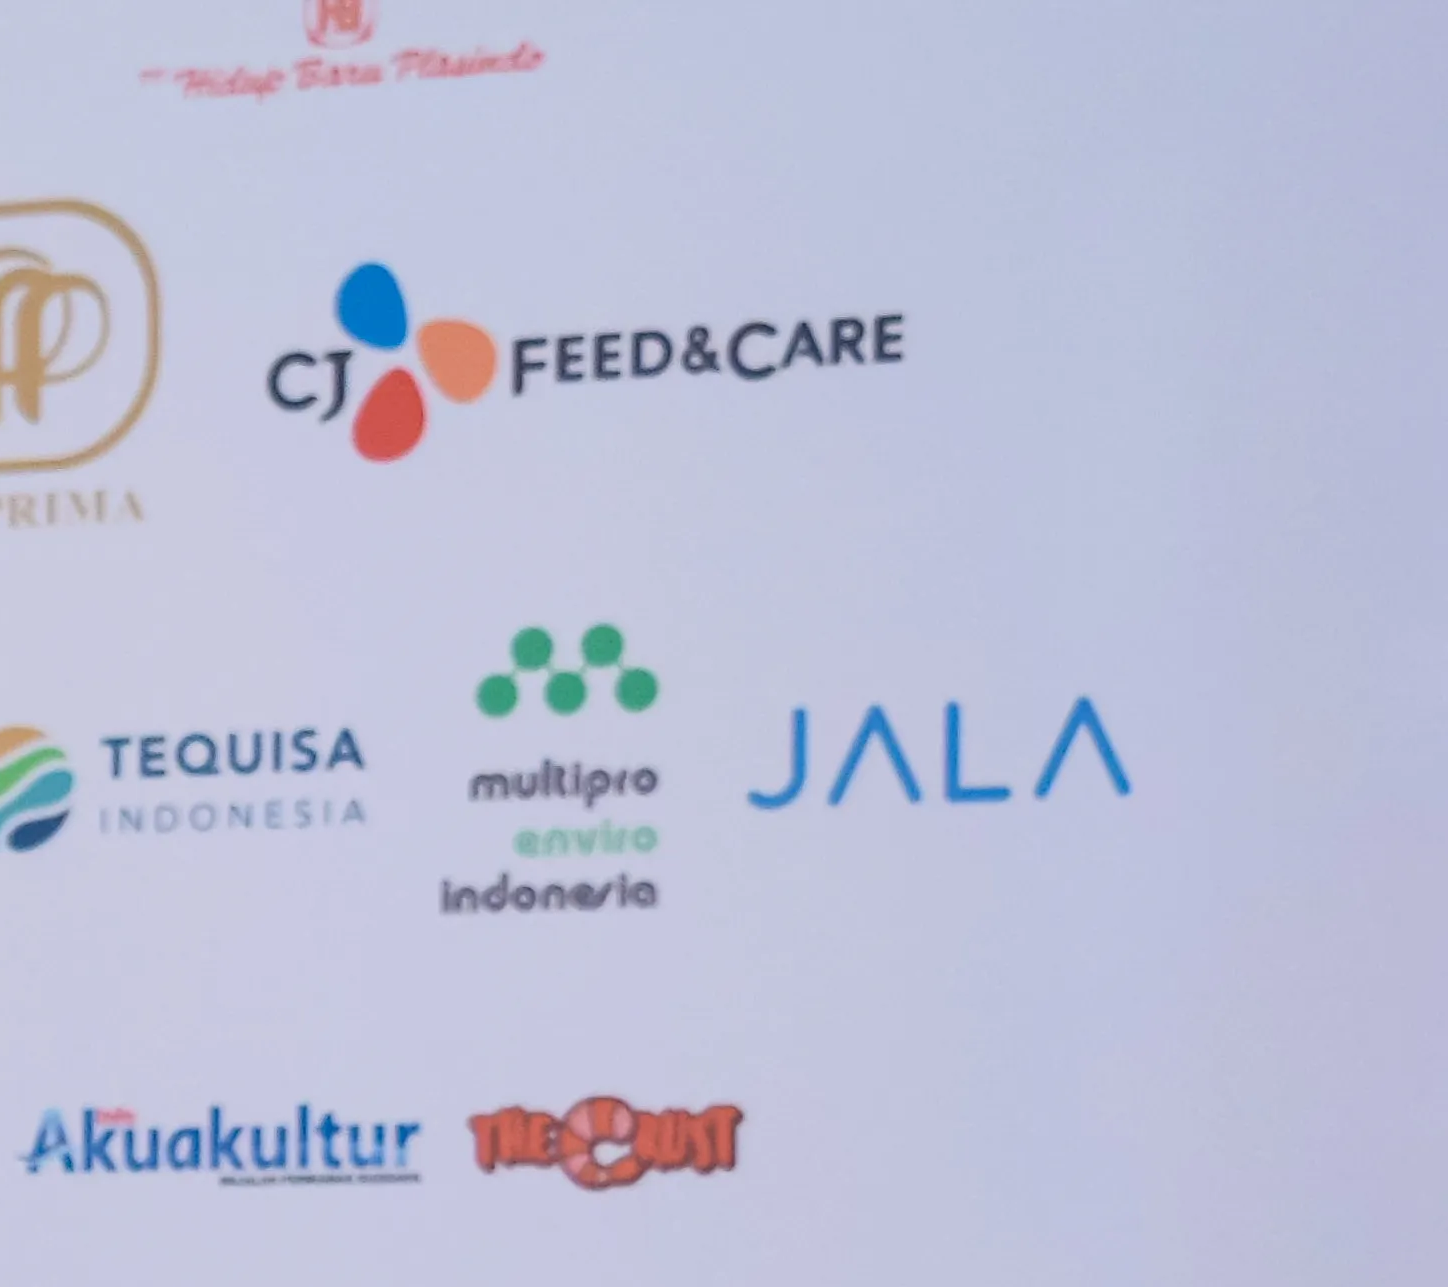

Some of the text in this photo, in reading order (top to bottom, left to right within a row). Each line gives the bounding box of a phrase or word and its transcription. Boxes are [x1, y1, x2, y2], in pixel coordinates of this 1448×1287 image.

[267, 314, 905, 424] CJ FEED&CARE
[100, 727, 366, 779] TEQUISA
[748, 697, 1132, 809] JALA
[468, 757, 661, 811] multipro
[99, 799, 367, 834] INDONESIA
[513, 819, 660, 858] enviro
[440, 871, 660, 915] indonesia
[19, 1103, 421, 1175] Akuakultur
